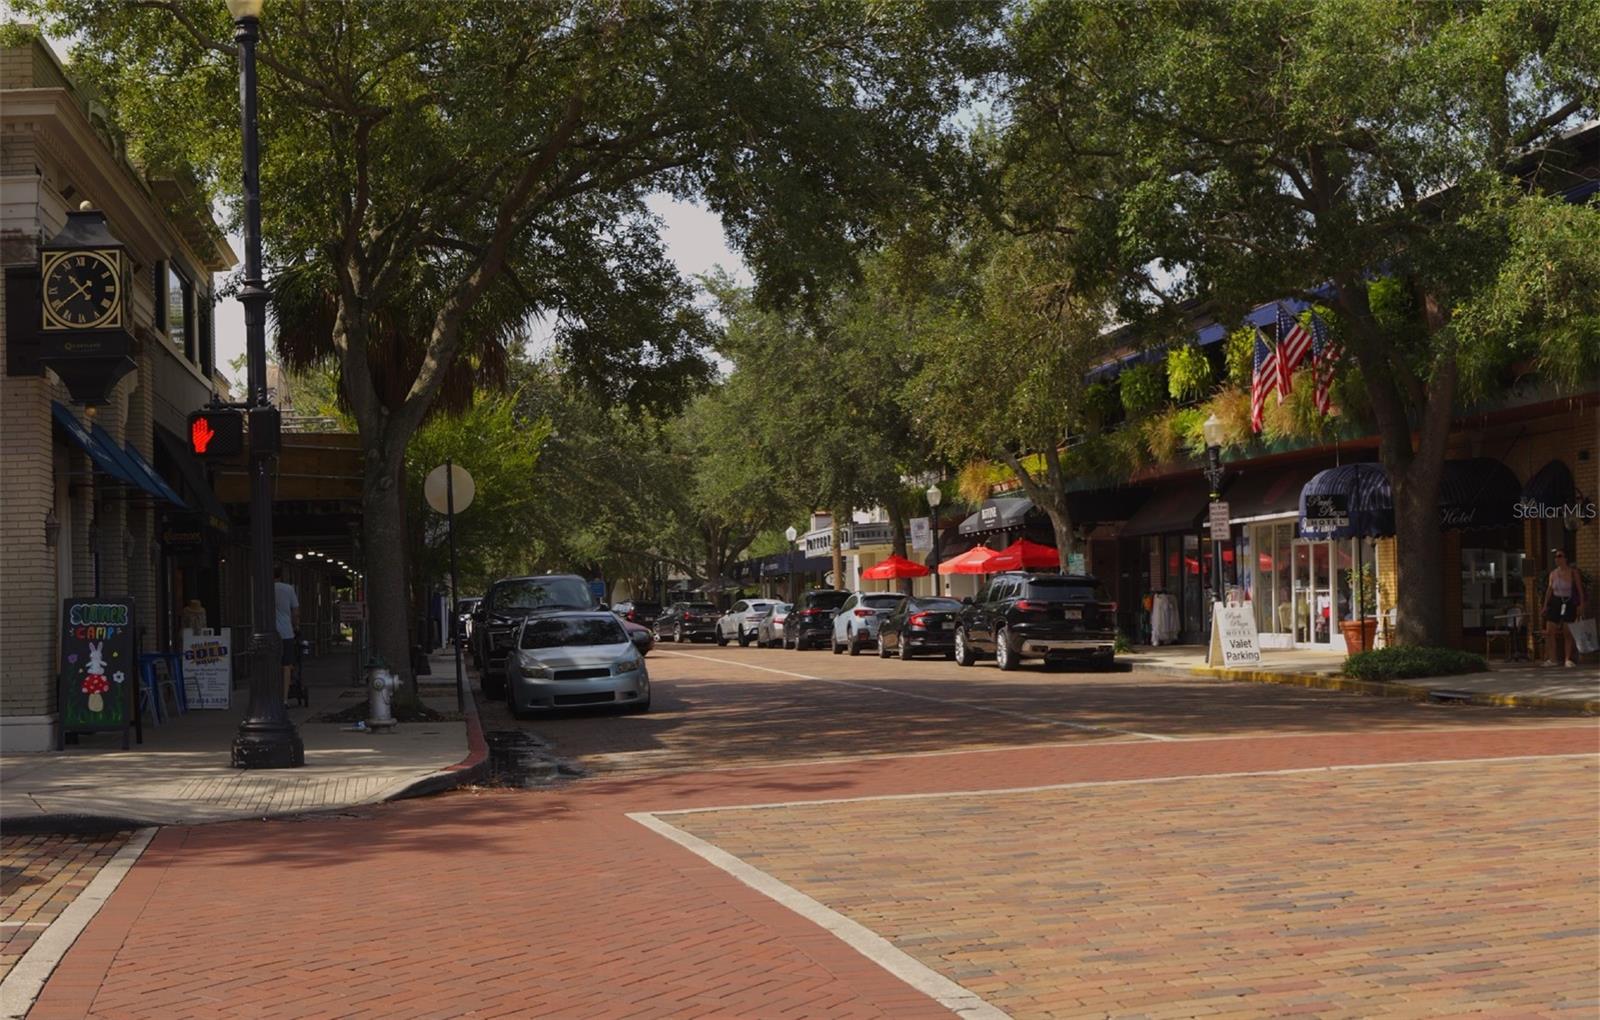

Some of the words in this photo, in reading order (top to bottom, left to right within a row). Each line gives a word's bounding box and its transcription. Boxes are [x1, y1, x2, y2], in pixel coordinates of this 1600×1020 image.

[1307, 496, 1334, 506] Park
[1441, 506, 1476, 524] Hotel
[75, 626, 114, 640] CAMP
[1229, 639, 1252, 648] Valet
[185, 646, 228, 660] GOLD
[1226, 651, 1260, 661] Parking
